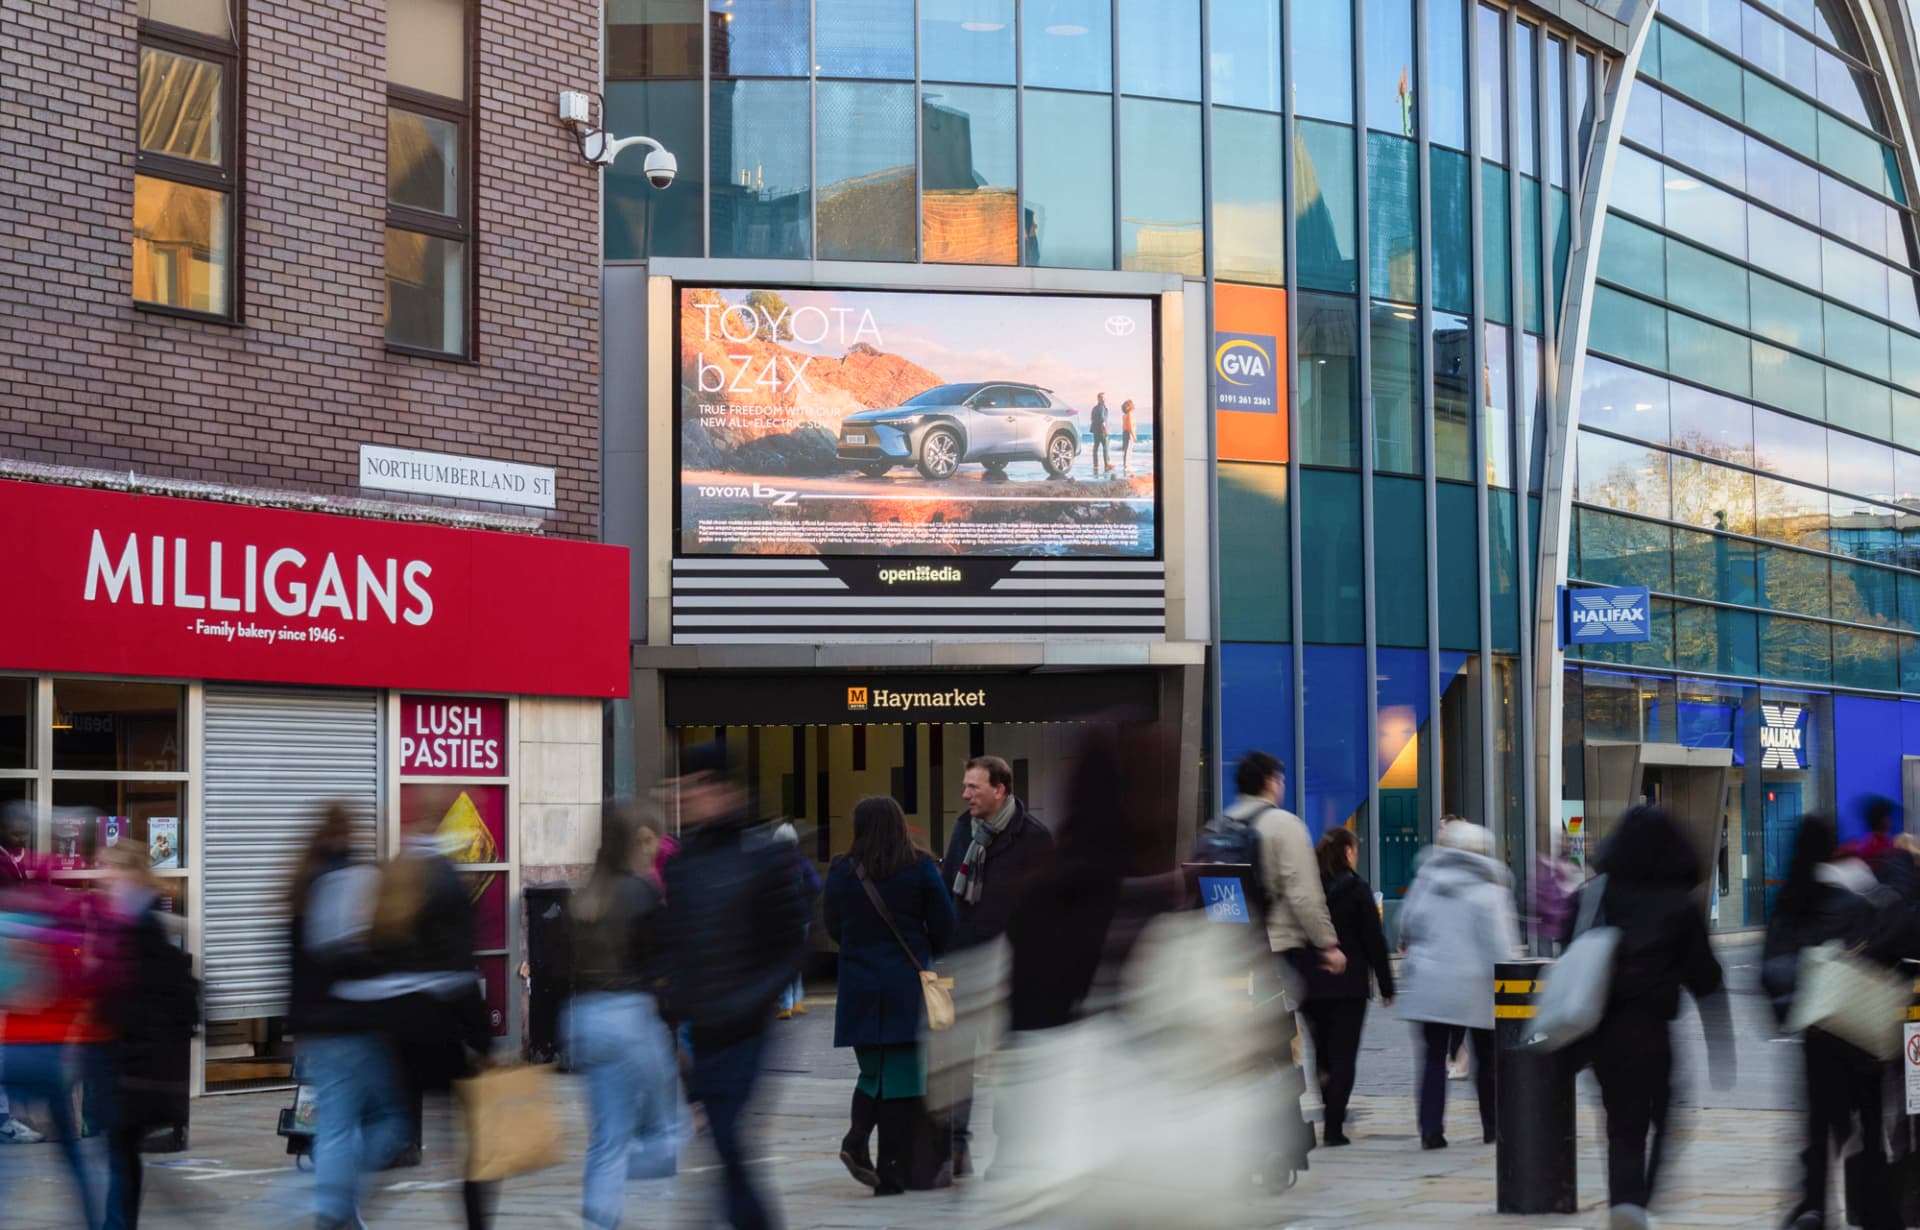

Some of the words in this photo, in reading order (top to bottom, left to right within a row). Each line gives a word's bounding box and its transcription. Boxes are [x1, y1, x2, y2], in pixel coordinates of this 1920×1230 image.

[696, 303, 883, 346] TOYOTA
[698, 352, 813, 394] bZ4X
[1223, 353, 1265, 377] GVA
[698, 404, 727, 415] TRUE
[729, 404, 782, 416] FREEDOM
[816, 406, 841, 417] OUR
[700, 418, 727, 428] NEW
[367, 457, 525, 493] NORTHUMBERLAND
[698, 486, 750, 498] TOYOTA
[84, 528, 434, 627] MILLIGANS
[1572, 606, 1645, 624] HALIFAX
[196, 619, 236, 642] Family
[237, 621, 276, 644] bakery
[278, 624, 306, 642] since
[308, 626, 337, 643] 1946
[873, 688, 986, 711] Haymarket
[416, 704, 482, 736] LUSH
[1760, 727, 1801, 749] HALIFAX
[400, 737, 499, 769] PASTIES
[1210, 884, 1236, 901] JW
[1213, 903, 1241, 916] ORG
